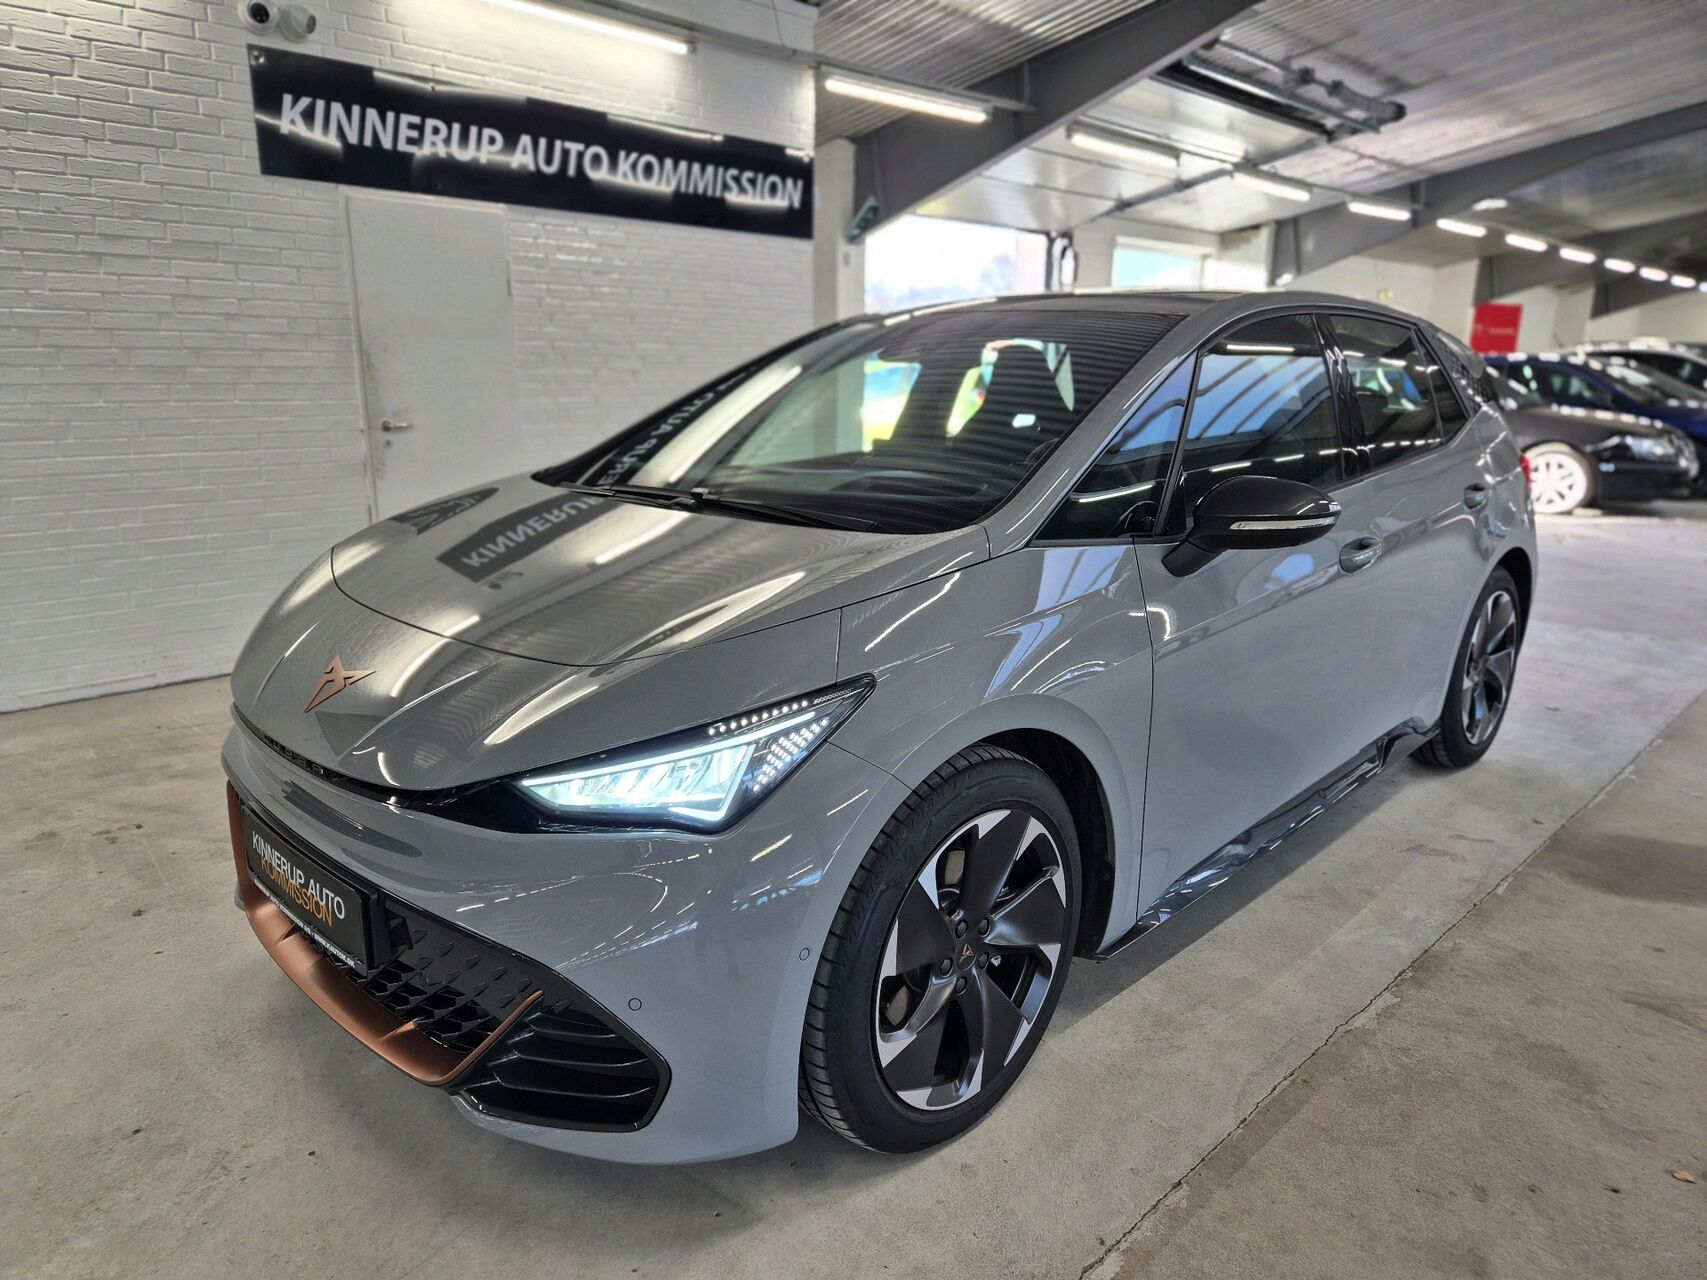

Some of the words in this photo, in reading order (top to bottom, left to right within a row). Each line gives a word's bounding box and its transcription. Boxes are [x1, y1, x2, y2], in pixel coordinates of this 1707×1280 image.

[279, 93, 504, 165] KINNERUP
[511, 134, 610, 181] AUTO
[615, 150, 804, 210] KOMMISSION
[252, 831, 305, 886] KINNERUP
[307, 878, 345, 920] AUTO
[261, 853, 332, 928] KOMMISSION
